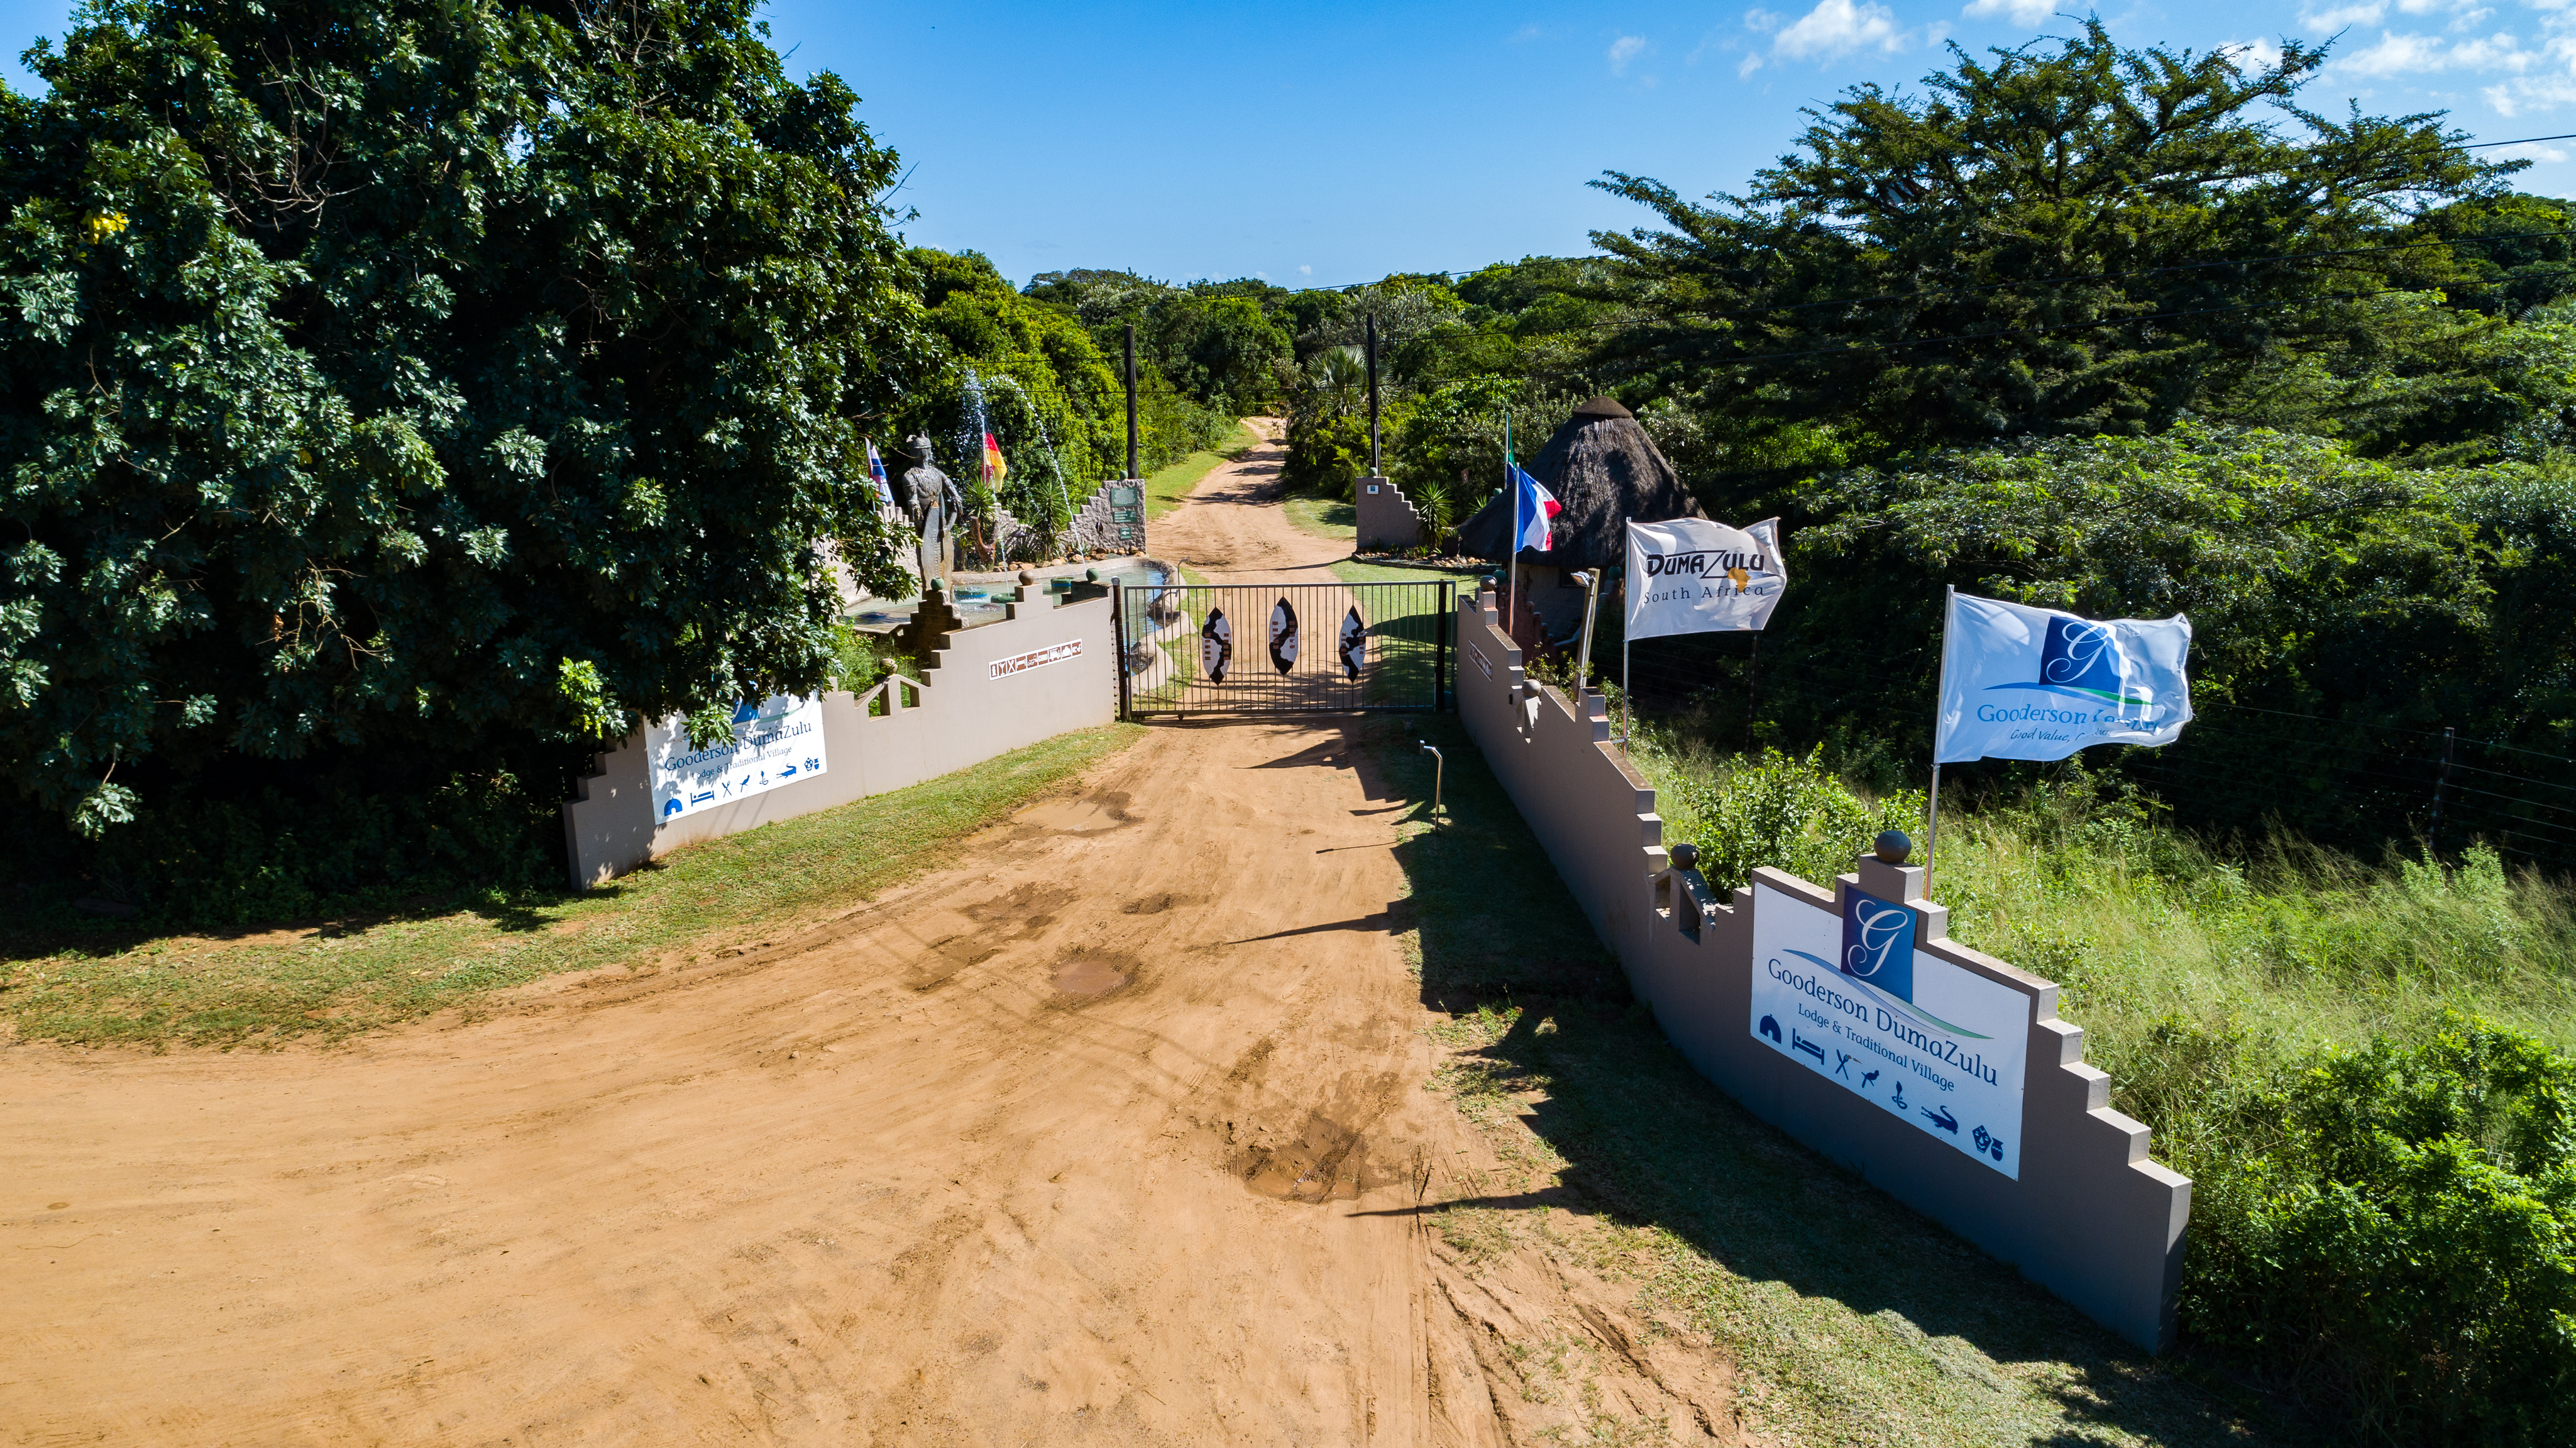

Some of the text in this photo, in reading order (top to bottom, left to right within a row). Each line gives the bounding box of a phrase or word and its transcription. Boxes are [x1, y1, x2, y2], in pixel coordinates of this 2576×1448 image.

[1644, 585, 1764, 604] South Africa
[1977, 704, 2086, 724] Gooderson
[742, 721, 812, 749] DumaZulu
[2039, 731, 2071, 743] Value,
[691, 746, 792, 780] Lodge & Traditional Village
[1847, 899, 1908, 976] G
[1768, 958, 1998, 1087] Gooderson DumaZulu
[1798, 1003, 1955, 1092] Lodge & Traditional Village
